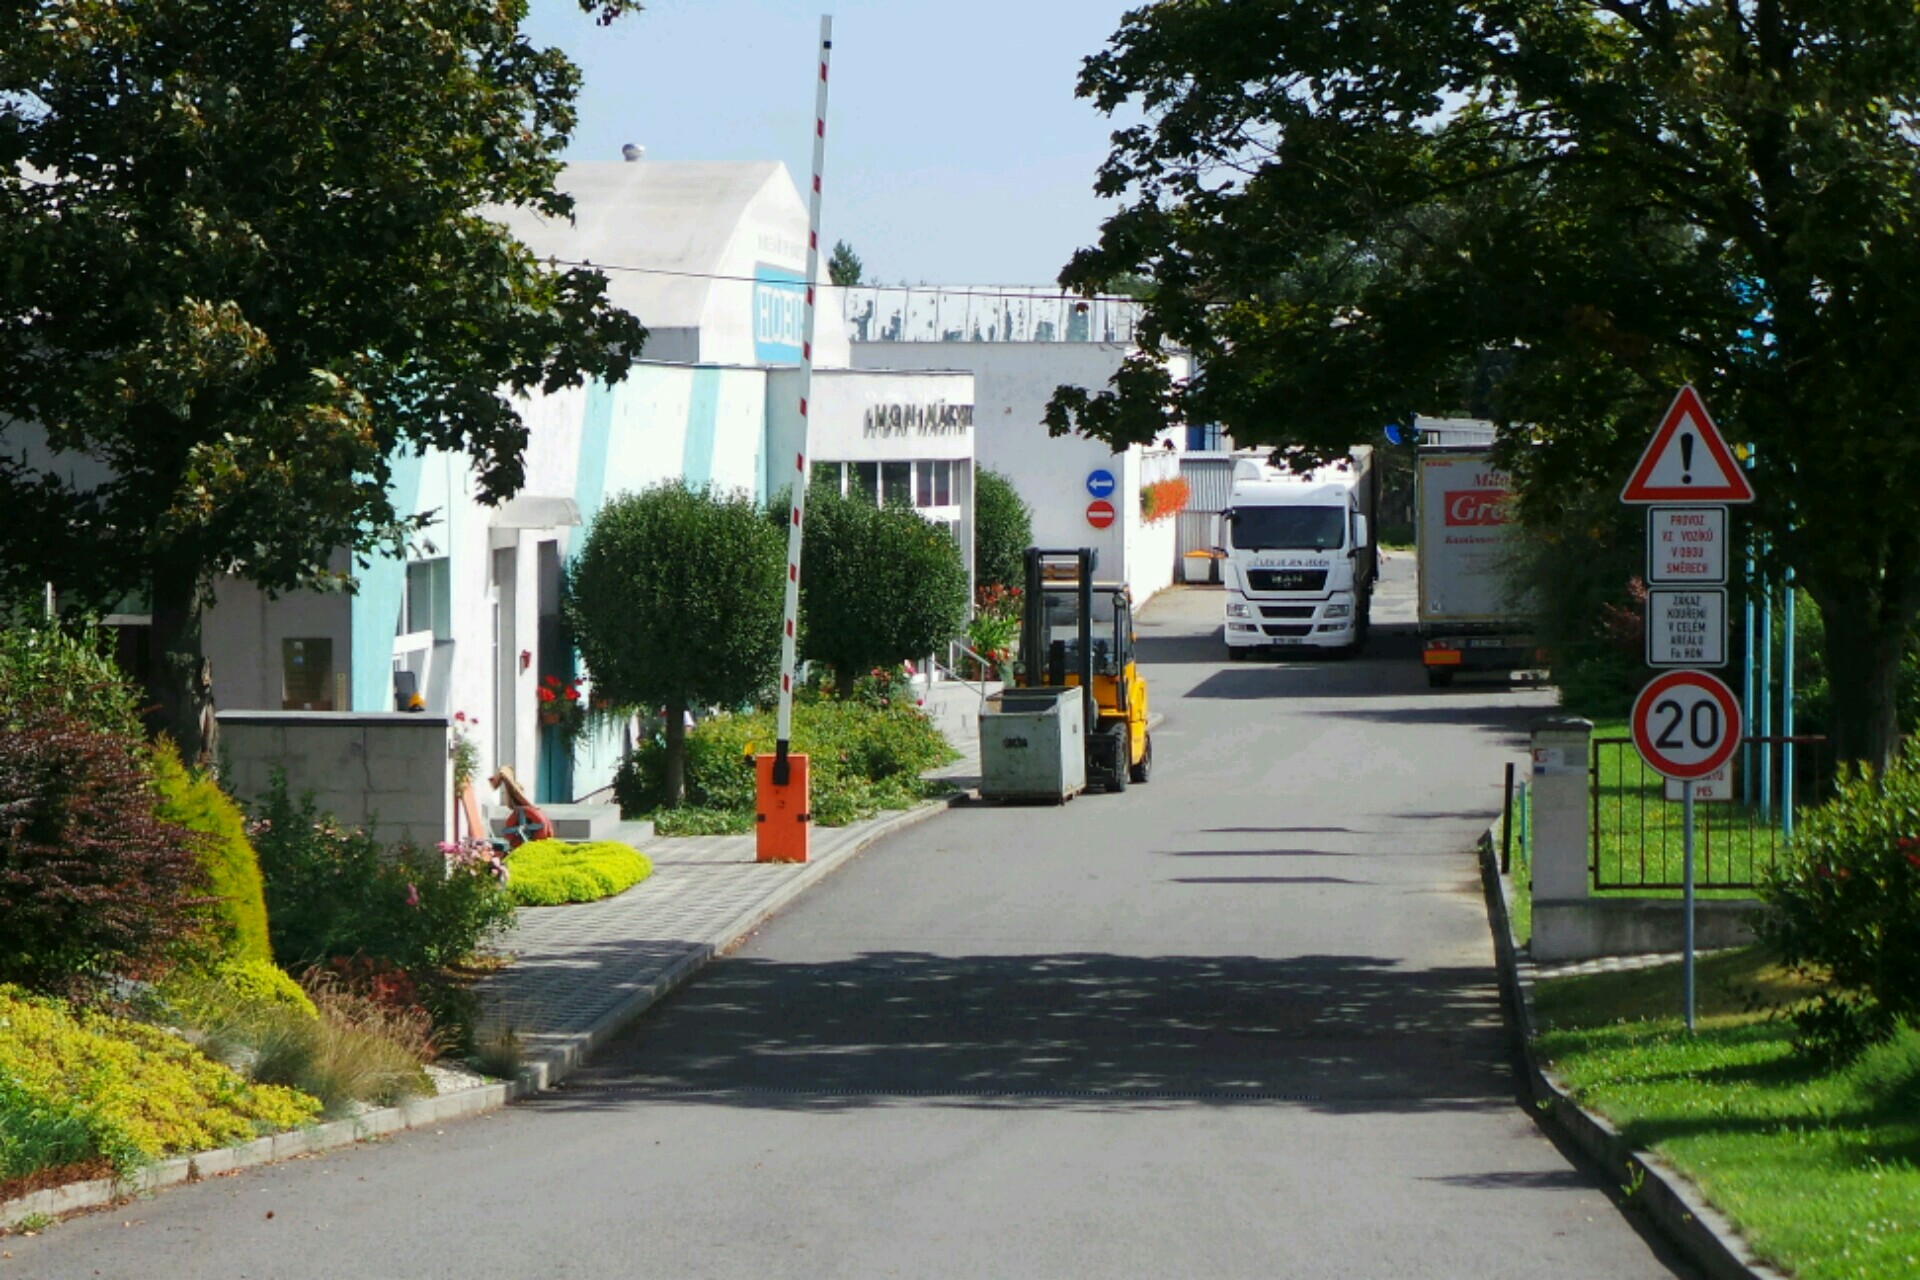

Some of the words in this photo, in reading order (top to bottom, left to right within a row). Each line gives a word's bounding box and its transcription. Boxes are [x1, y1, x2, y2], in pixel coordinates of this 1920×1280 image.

[1670, 515, 1704, 526] PROVOZ
[1671, 547, 1677, 557] V
[1679, 547, 1704, 558] OBOU
[1666, 561, 1709, 574] SMĚRECH
[1666, 606, 1707, 619] KOUŘENÍ
[1676, 618, 1706, 632] CELÉM
[1655, 699, 1719, 749] 20
